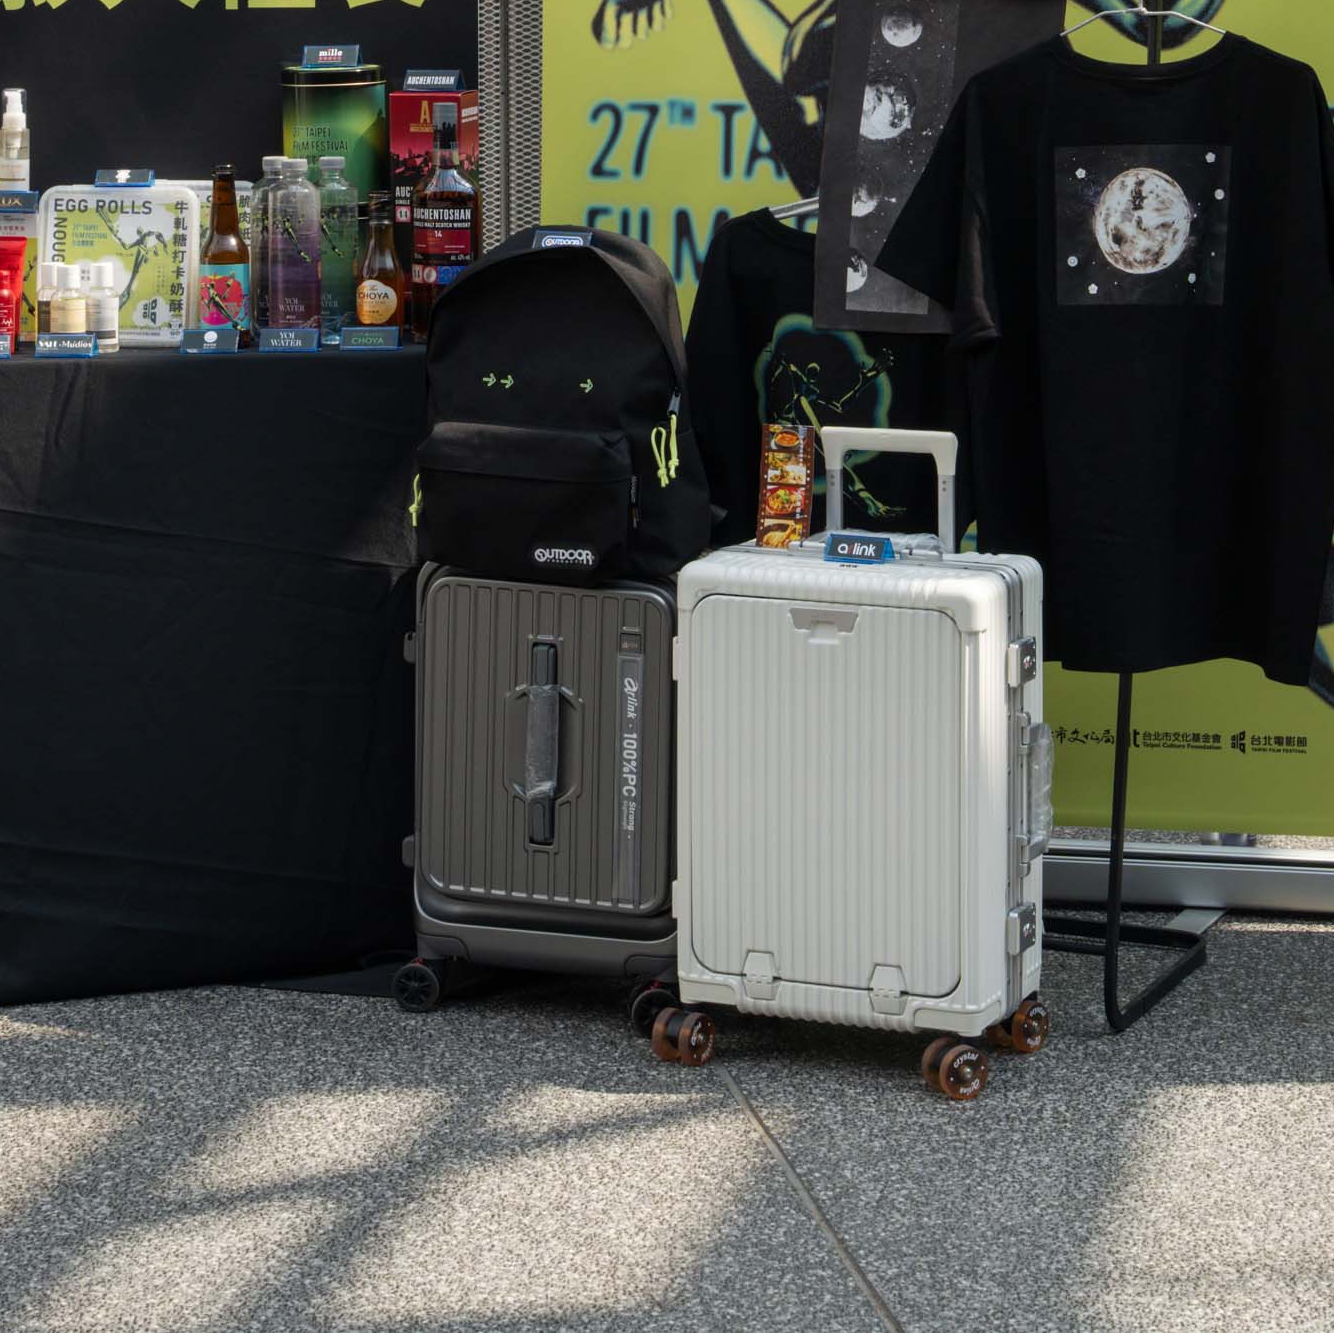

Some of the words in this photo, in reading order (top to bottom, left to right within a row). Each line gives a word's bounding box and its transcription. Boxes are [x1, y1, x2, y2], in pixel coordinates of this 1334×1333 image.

[53, 198, 88, 213] EGG
[96, 200, 153, 215] ROLLS
[534, 546, 595, 567] OUTDOOR
[837, 543, 877, 557] arlink
